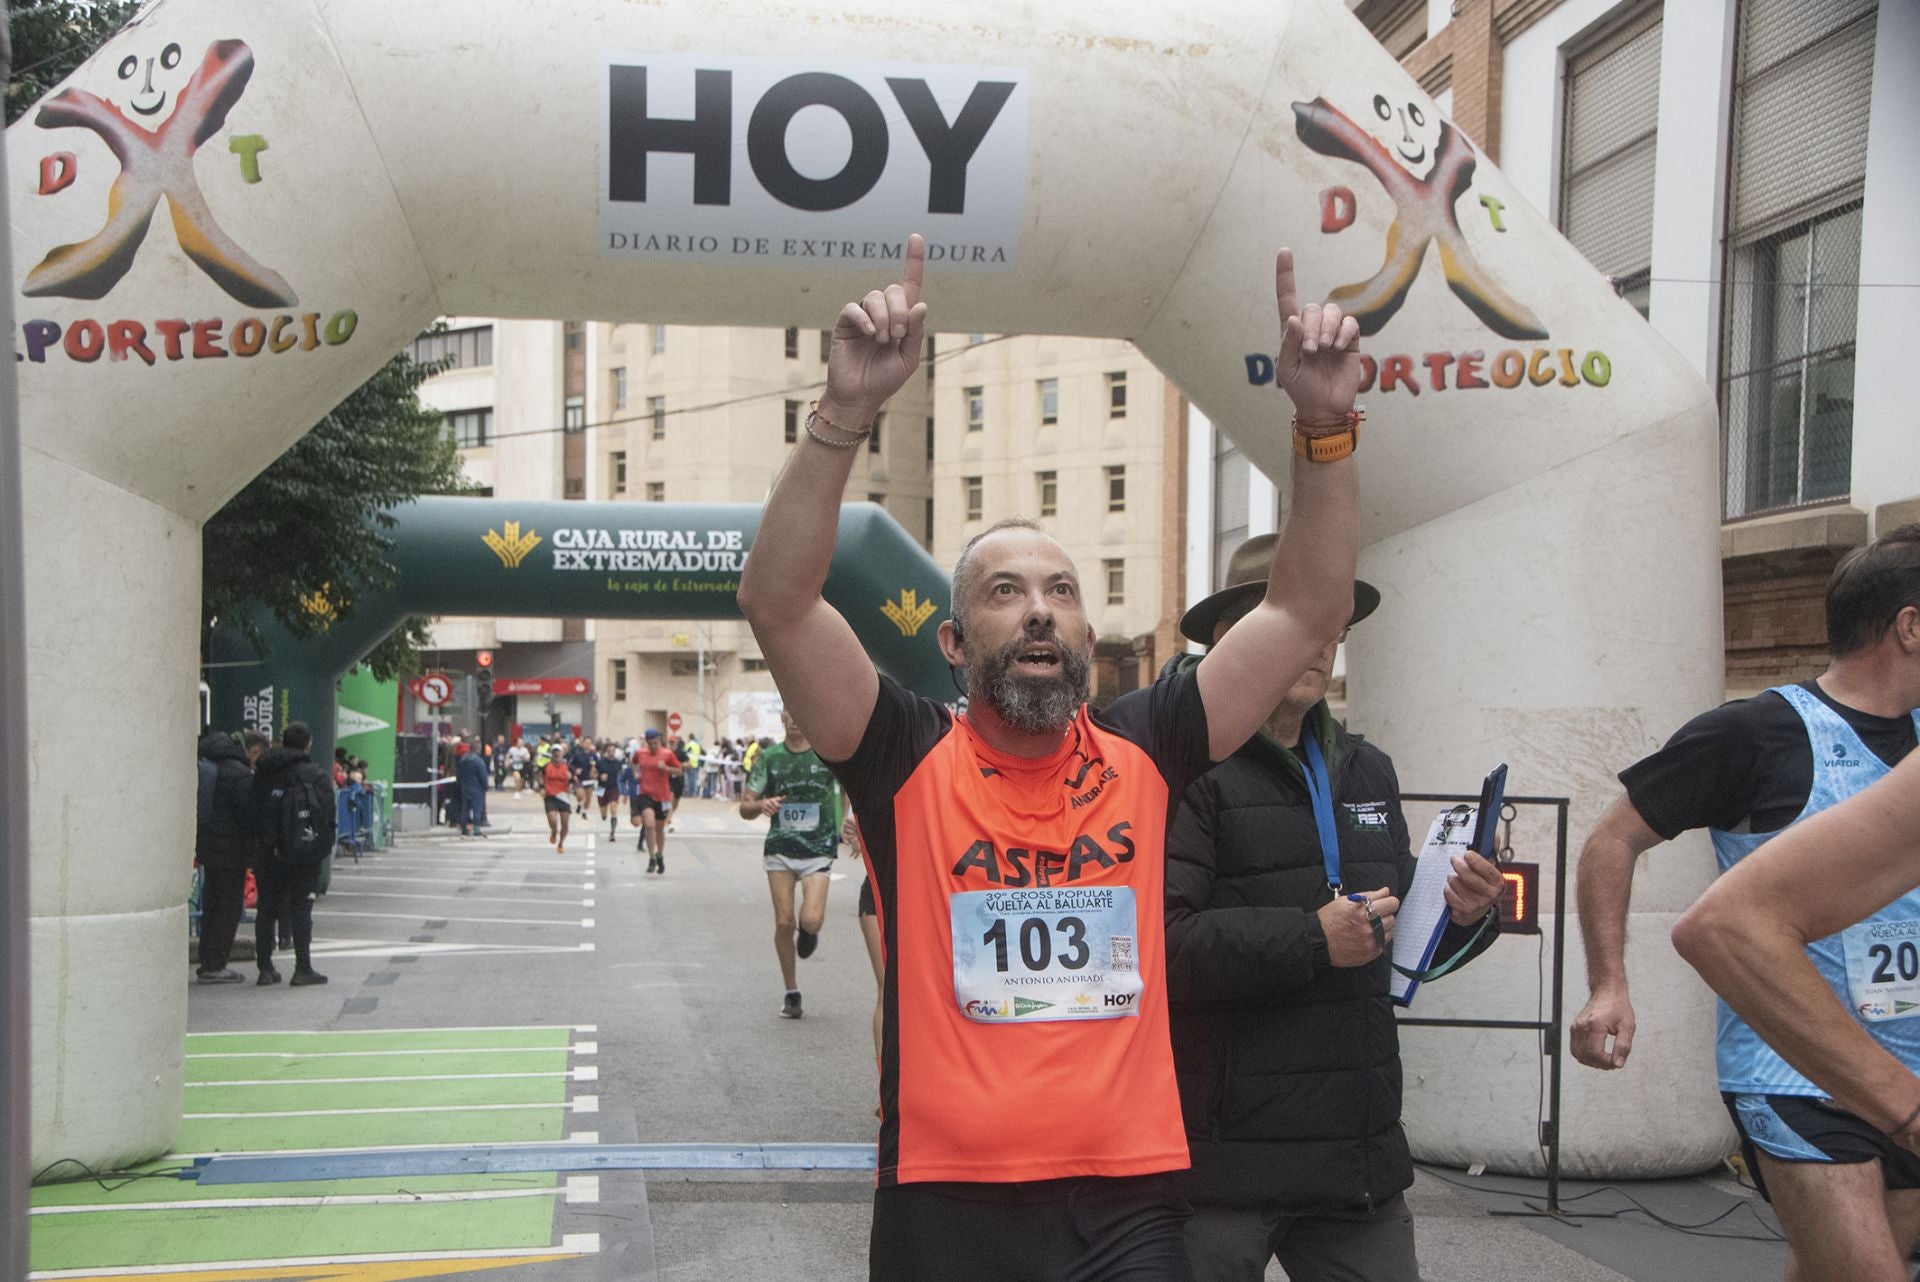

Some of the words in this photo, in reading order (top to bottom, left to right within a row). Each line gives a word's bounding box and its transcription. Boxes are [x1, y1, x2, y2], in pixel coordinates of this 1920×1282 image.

[608, 64, 1019, 215] HOY
[38, 151, 77, 196] D
[228, 134, 270, 184] T
[1319, 185, 1357, 234] D
[1478, 194, 1507, 233] T
[608, 231, 719, 254] DIARIO
[732, 236, 770, 256] DE
[782, 239, 1008, 264] EXTREMDURA
[14, 310, 358, 366] PORTEOCIO
[1245, 348, 1612, 397] DORTEOCIO
[553, 528, 615, 550] CAJA
[618, 530, 703, 550] RURAL
[707, 531, 743, 551] DE
[1824, 759, 1860, 768] VIATOR
[1070, 766, 1119, 810] ANDRADE
[783, 810, 806, 821] 607
[952, 821, 1136, 888] ASFAS
[986, 900, 1031, 911] VUELTA
[1036, 900, 1052, 910] AL
[1055, 897, 1113, 910] BALUARTE
[1011, 890, 1054, 900] CROSS
[1057, 889, 1113, 899] POPULAR
[1870, 929, 1904, 938] VUELTA
[1907, 927, 1917, 935] AL
[1888, 921, 1919, 929] CROSS
[983, 916, 1091, 973] 103
[1868, 941, 1918, 984] 20
[1004, 976, 1054, 986] ANTONIO
[1104, 993, 1136, 1006] HOY
